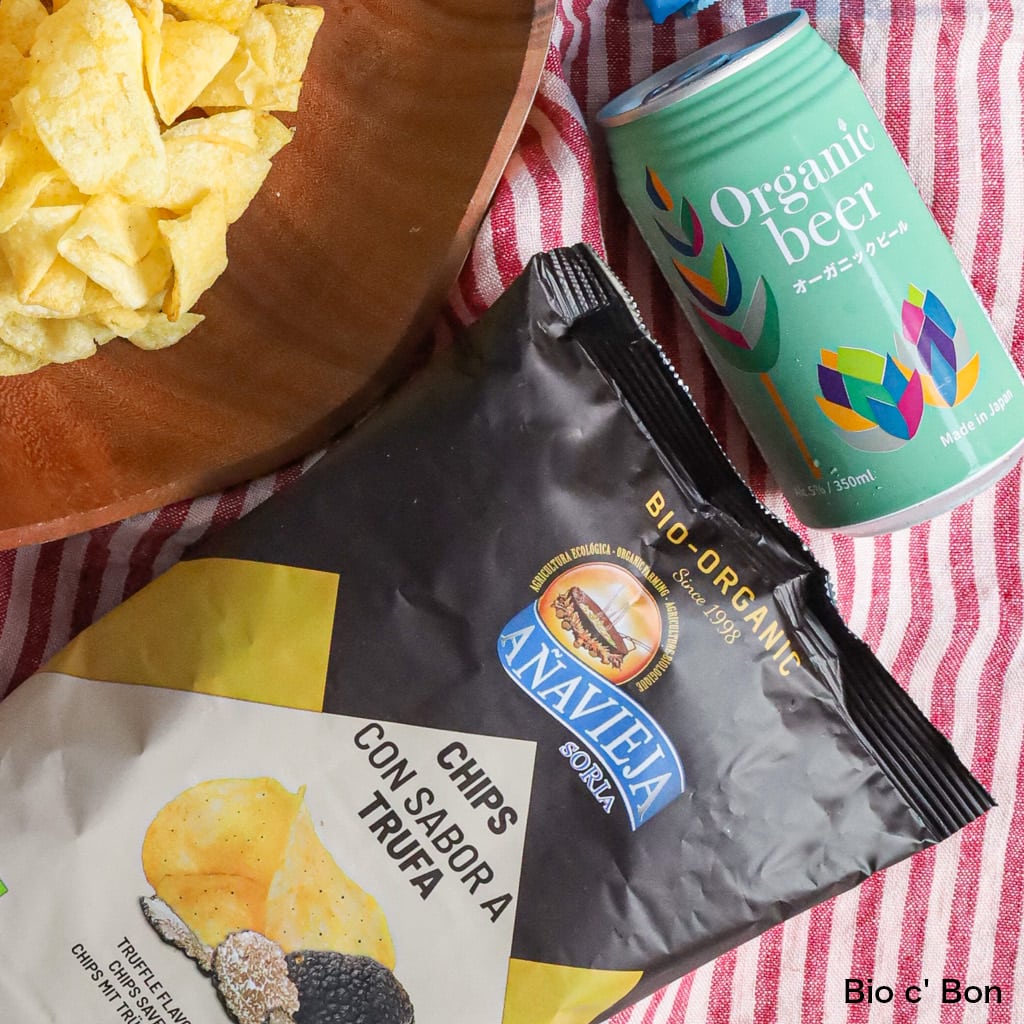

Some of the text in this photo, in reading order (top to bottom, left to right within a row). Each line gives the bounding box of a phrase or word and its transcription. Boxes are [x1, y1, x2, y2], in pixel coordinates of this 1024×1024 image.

[709, 117, 875, 228] Organic
[760, 181, 881, 265] beer
[792, 220, 908, 294] オーガニックビール
[940, 389, 1013, 448] Made in Japan
[833, 468, 875, 492] 350ml
[529, 551, 573, 593] AGRICULTURA
[570, 542, 611, 559] ECOLÓGICA
[616, 546, 645, 570] ORGANIC
[641, 564, 671, 597] FARMING
[645, 490, 801, 677] BIO-ORGANIC
[672, 568, 741, 645] Since 1998
[636, 651, 673, 692] BIOLOGIQUE
[499, 624, 673, 821] AÑAVIEJA
[436, 741, 518, 835] CHIPS
[558, 741, 614, 815] SORIA
[354, 722, 514, 923] CON SABOR A
[357, 790, 444, 901] TRUFA
[71, 943, 104, 982] CHIPS
[98, 979, 121, 1002] MIT
[108, 960, 141, 998] CHIPS
[117, 936, 163, 994] TRUFFLE
